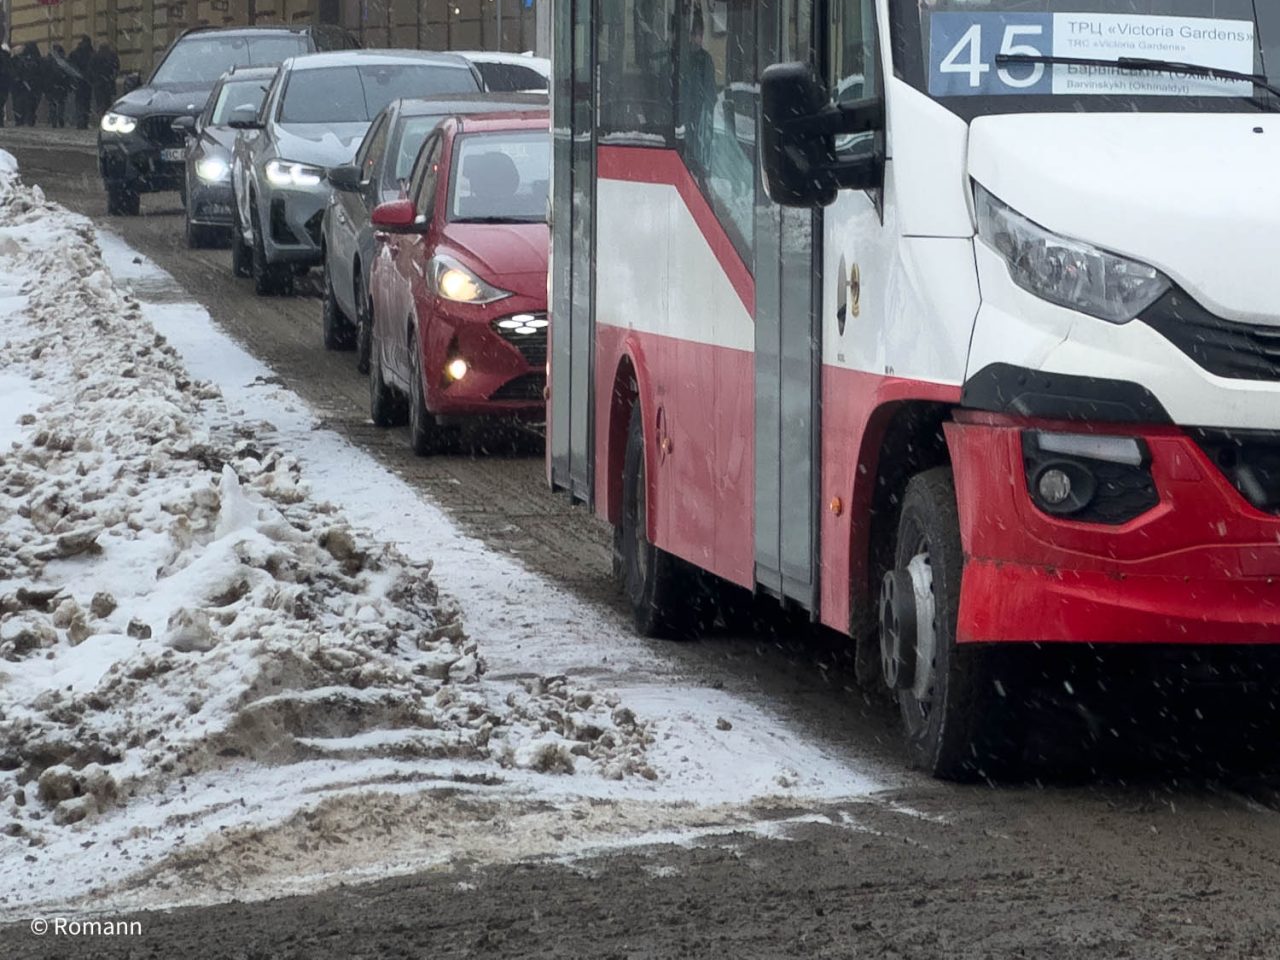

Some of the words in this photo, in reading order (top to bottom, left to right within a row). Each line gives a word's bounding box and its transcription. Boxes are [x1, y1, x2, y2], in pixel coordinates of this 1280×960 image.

[1068, 21, 1102, 36] ТРЦ
[1108, 22, 1174, 38] «Victoria
[1179, 25, 1254, 43] Gardens»
[939, 23, 1045, 89] 45
